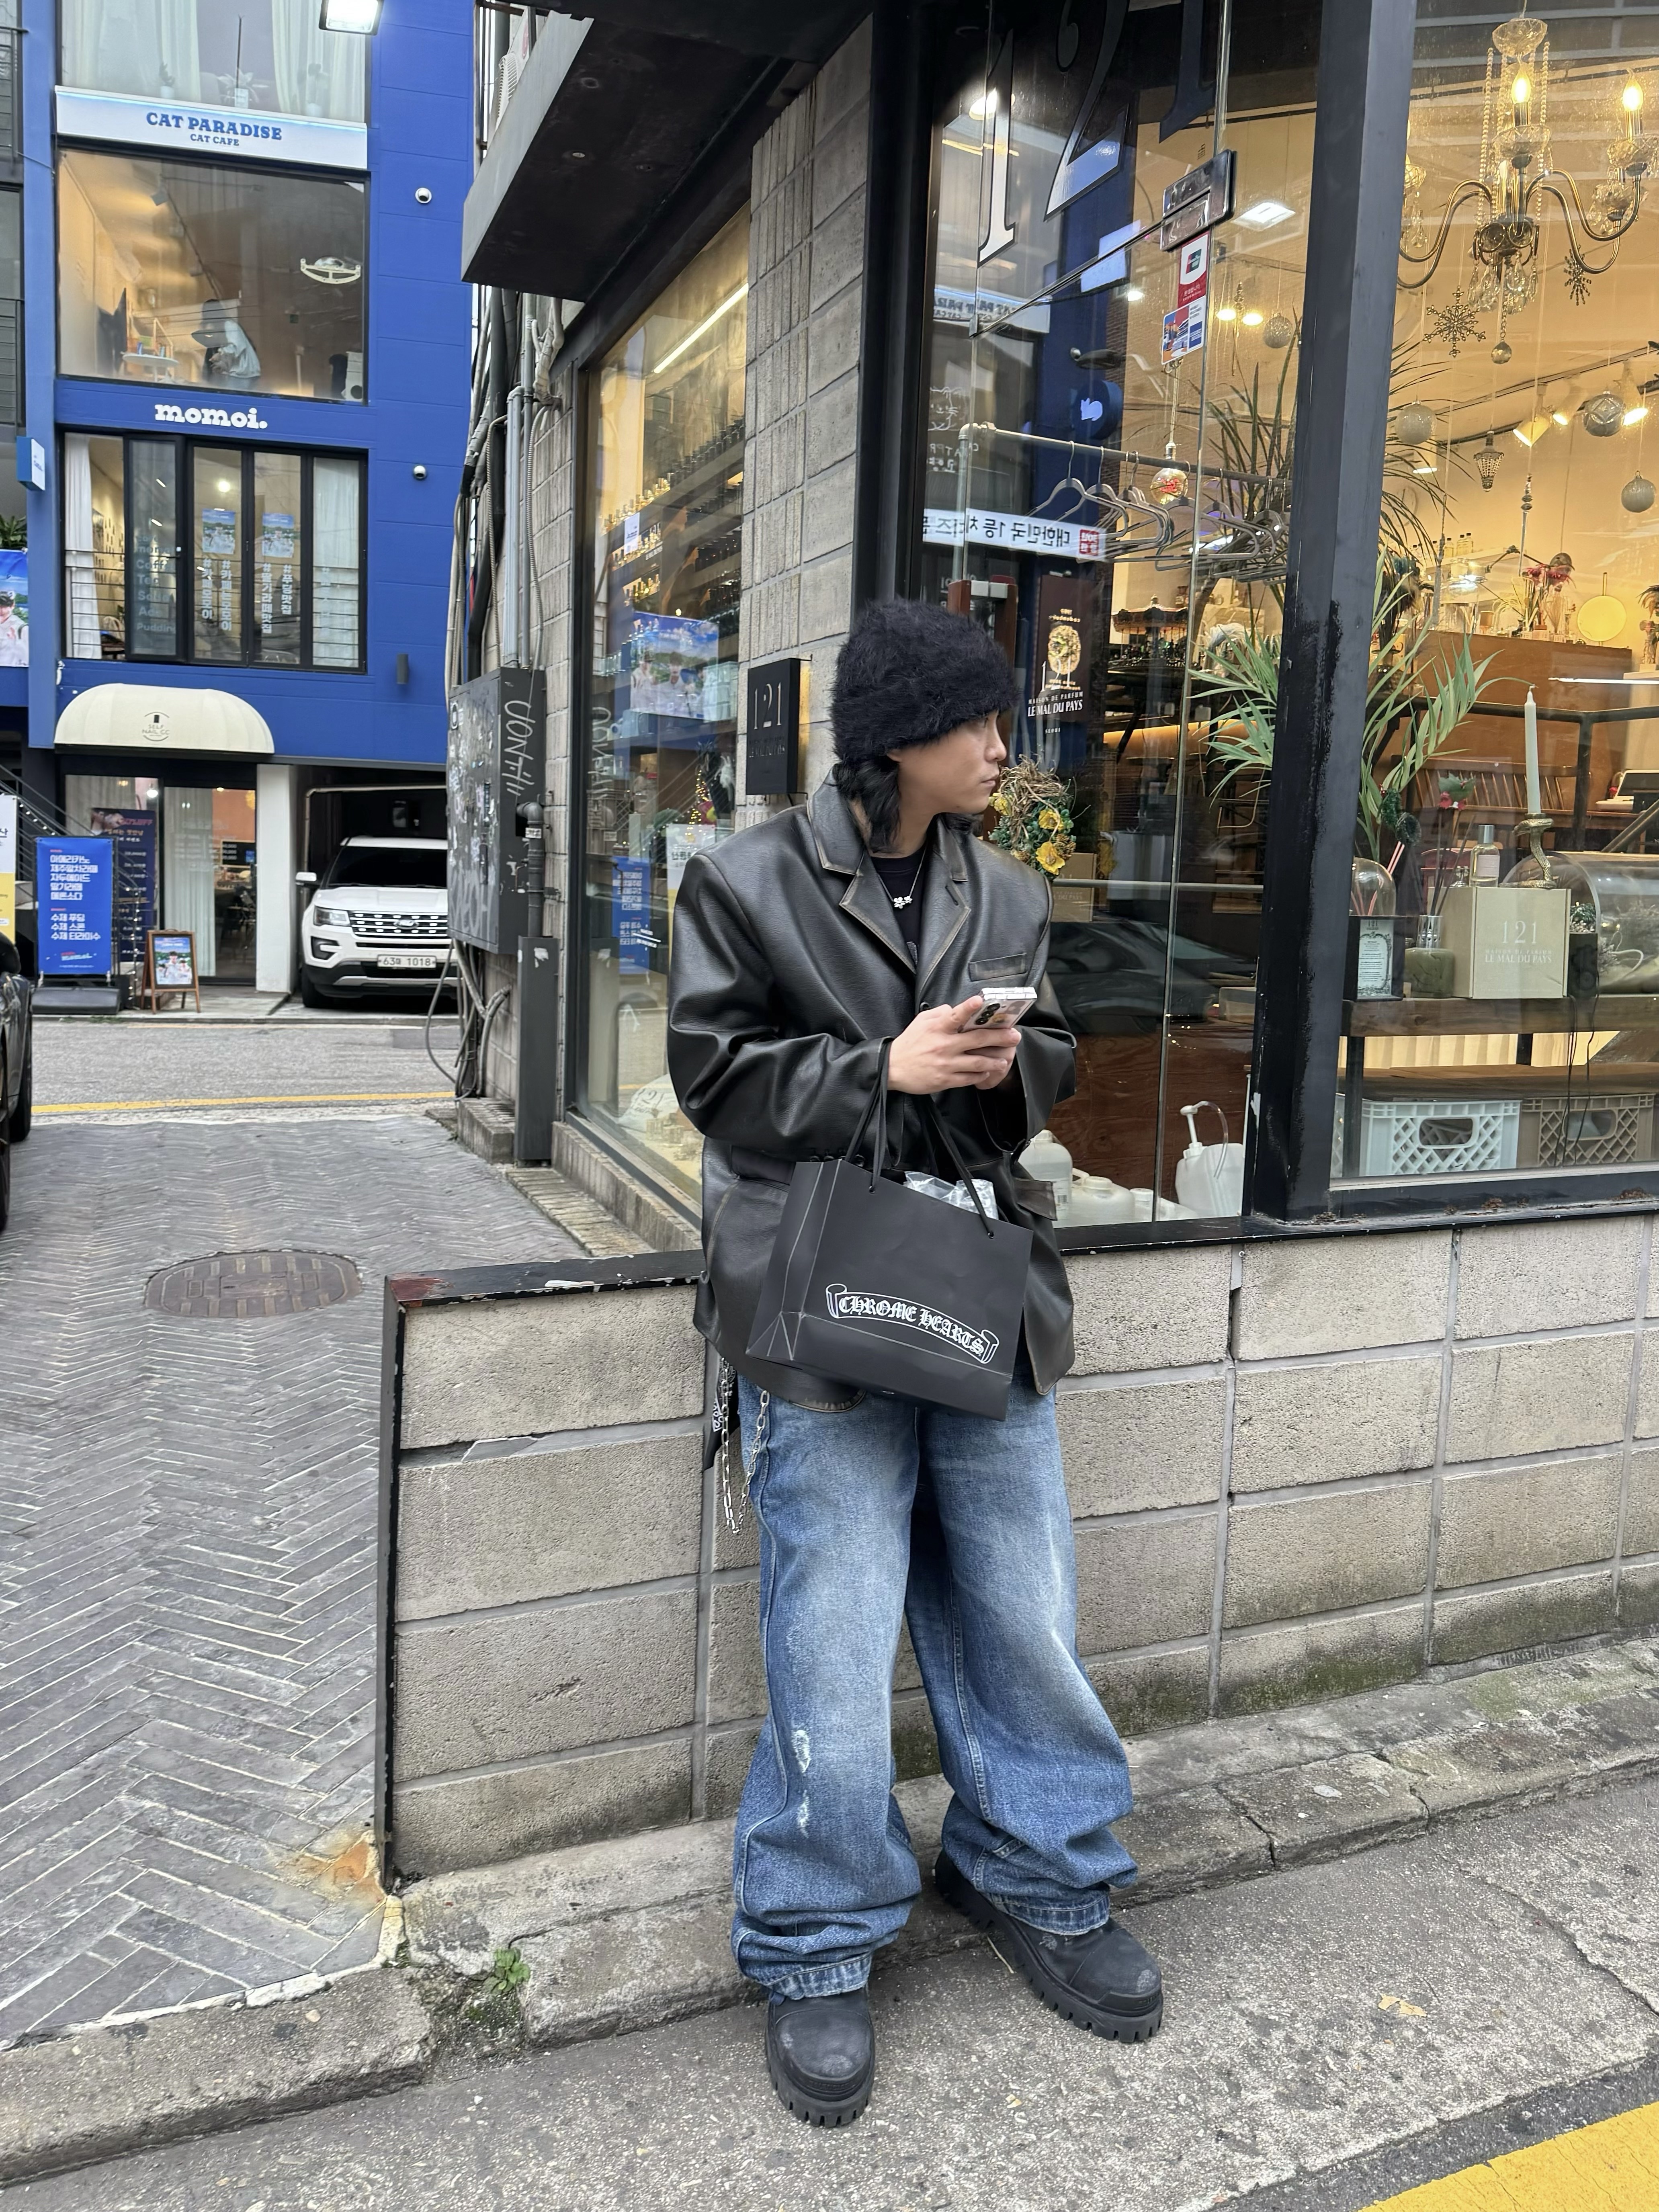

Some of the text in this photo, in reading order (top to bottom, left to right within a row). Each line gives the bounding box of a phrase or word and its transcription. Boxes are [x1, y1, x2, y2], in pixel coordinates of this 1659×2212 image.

[146, 112, 282, 141] CAT PARADISE
[977, 0, 1216, 263] 121
[190, 133, 240, 146] CAT CAFE
[154, 404, 268, 429] momoi.
[1041, 655, 1071, 692] 121
[1028, 696, 1049, 705] MAISON
[1061, 691, 1083, 700] PARFUM
[754, 682, 781, 729] 121
[1028, 699, 1083, 717] LE MAL DU PAYS
[50, 854, 90, 864] 아메리카노
[50, 864, 98, 873] 제주말차라떼
[50, 873, 91, 882] 자두에이드
[50, 883, 83, 891] 딸기라떼
[51, 891, 83, 900] 메론소다
[51, 913, 85, 922] 수제 푸딩
[51, 922, 86, 931] 수제 스콘
[51, 932, 101, 940] 수제 티라미수
[1502, 921, 1537, 944] 121
[407, 957, 431, 966] 1018
[1485, 954, 1552, 963] LE MAL DU PAYS
[838, 1295, 985, 1355] CHROME HEARTS
